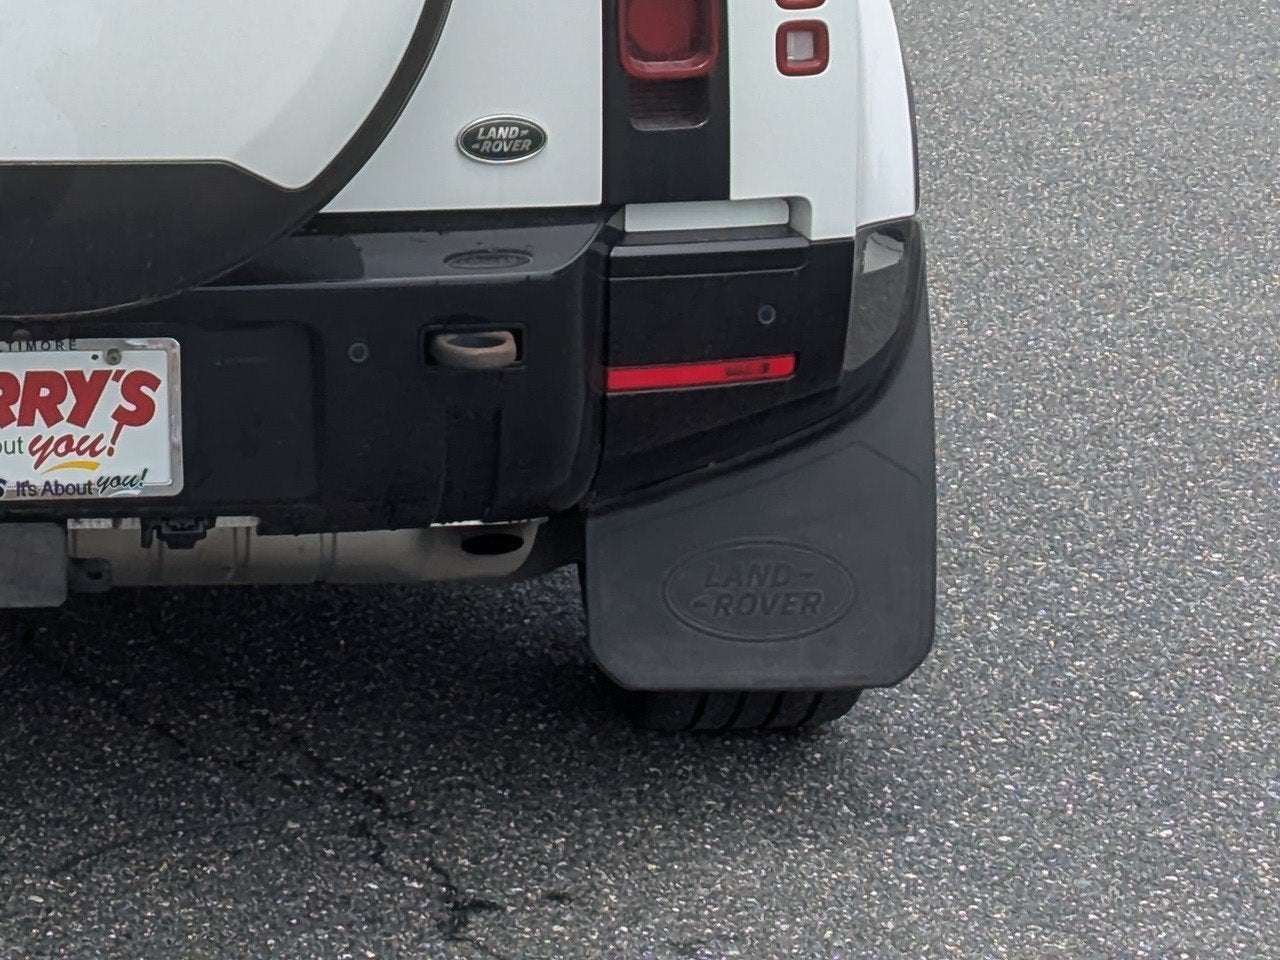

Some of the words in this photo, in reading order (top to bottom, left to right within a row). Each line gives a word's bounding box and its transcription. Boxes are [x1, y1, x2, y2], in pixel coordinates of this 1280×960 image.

[477, 126, 520, 140] LAND
[480, 139, 533, 153] ROVER
[28, 423, 125, 471] you!
[16, 480, 38, 497] It's
[41, 479, 94, 496] About
[96, 467, 149, 495] you!
[704, 562, 792, 588] LAND
[713, 591, 823, 617] ROVER
